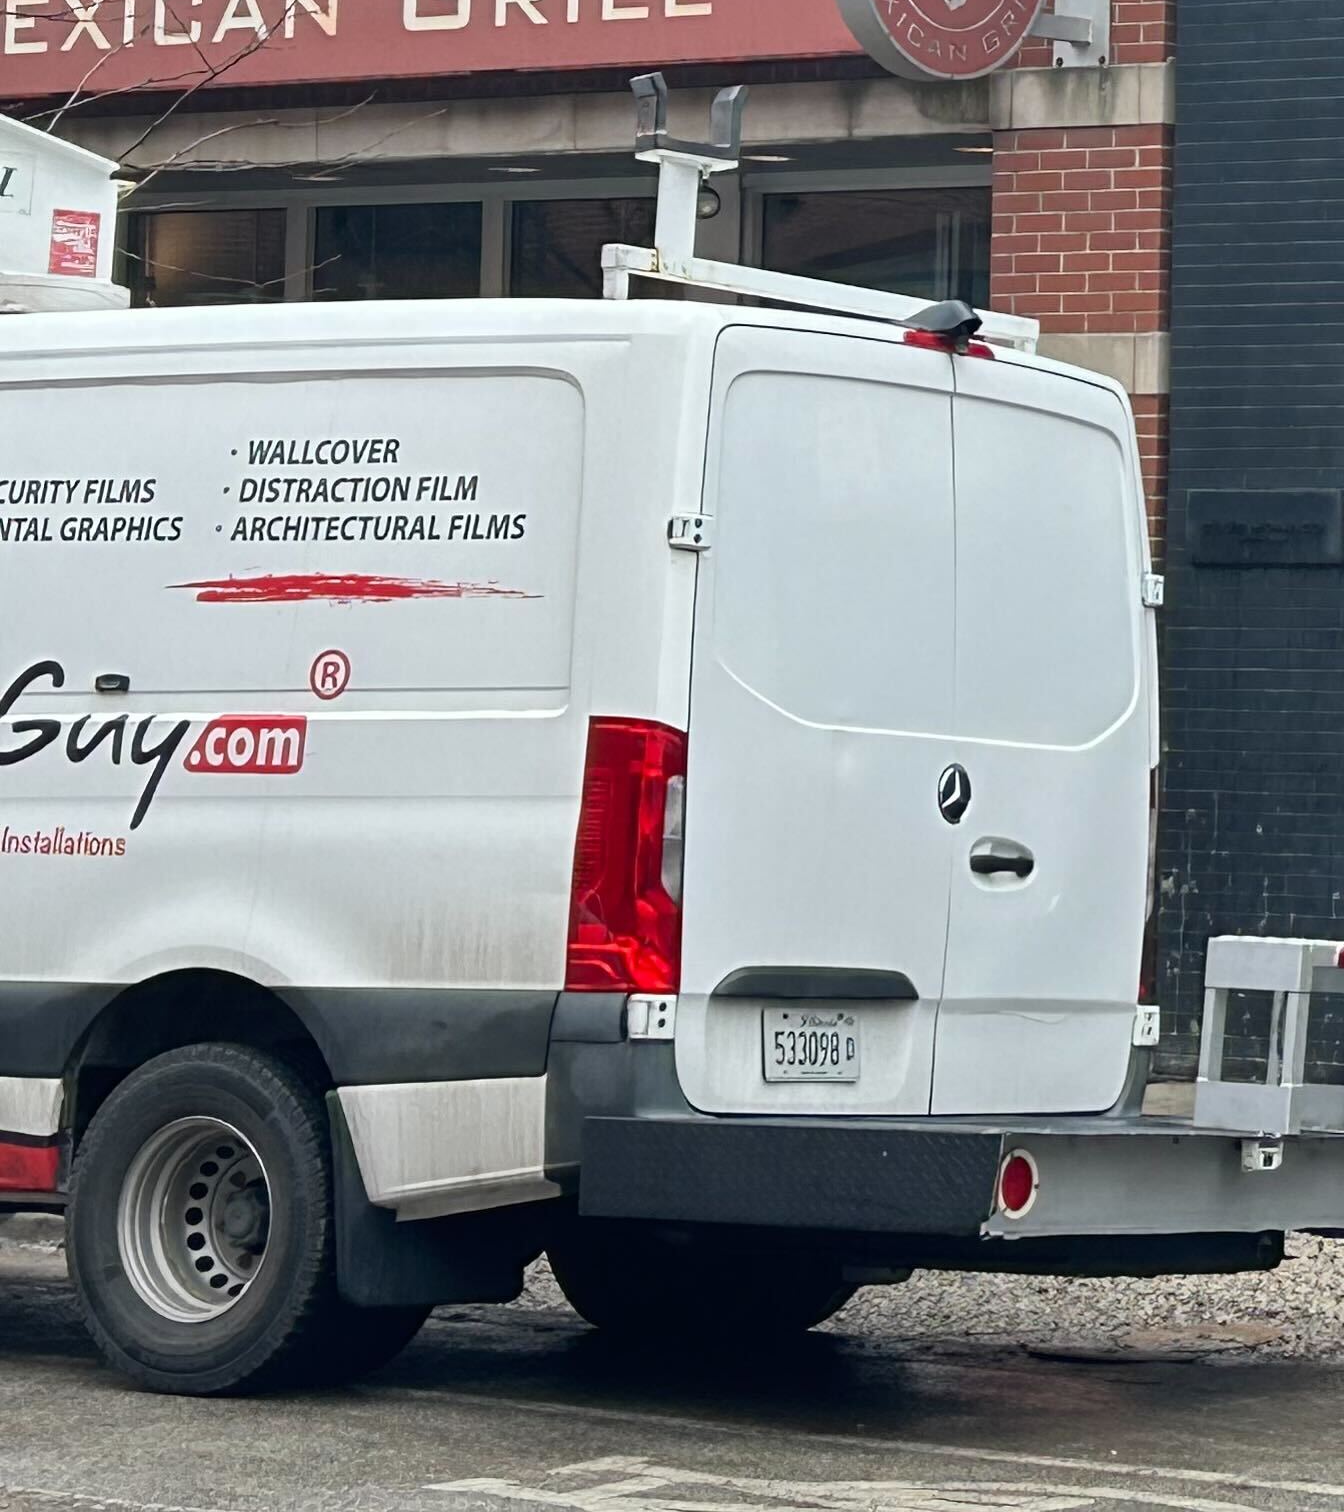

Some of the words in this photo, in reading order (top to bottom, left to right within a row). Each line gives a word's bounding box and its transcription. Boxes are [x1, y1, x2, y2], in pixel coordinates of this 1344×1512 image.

[248, 438, 400, 465] WALLCOVER
[83, 478, 156, 504] FILMS
[239, 476, 412, 503] DISTRACTION
[415, 475, 478, 501] FILM
[60, 516, 183, 542] GRAPHICS
[230, 515, 441, 541] ARCHITECTURAL
[447, 514, 526, 540] FILMS
[1, 825, 126, 857] Installations
[774, 1031, 840, 1067] 533098
